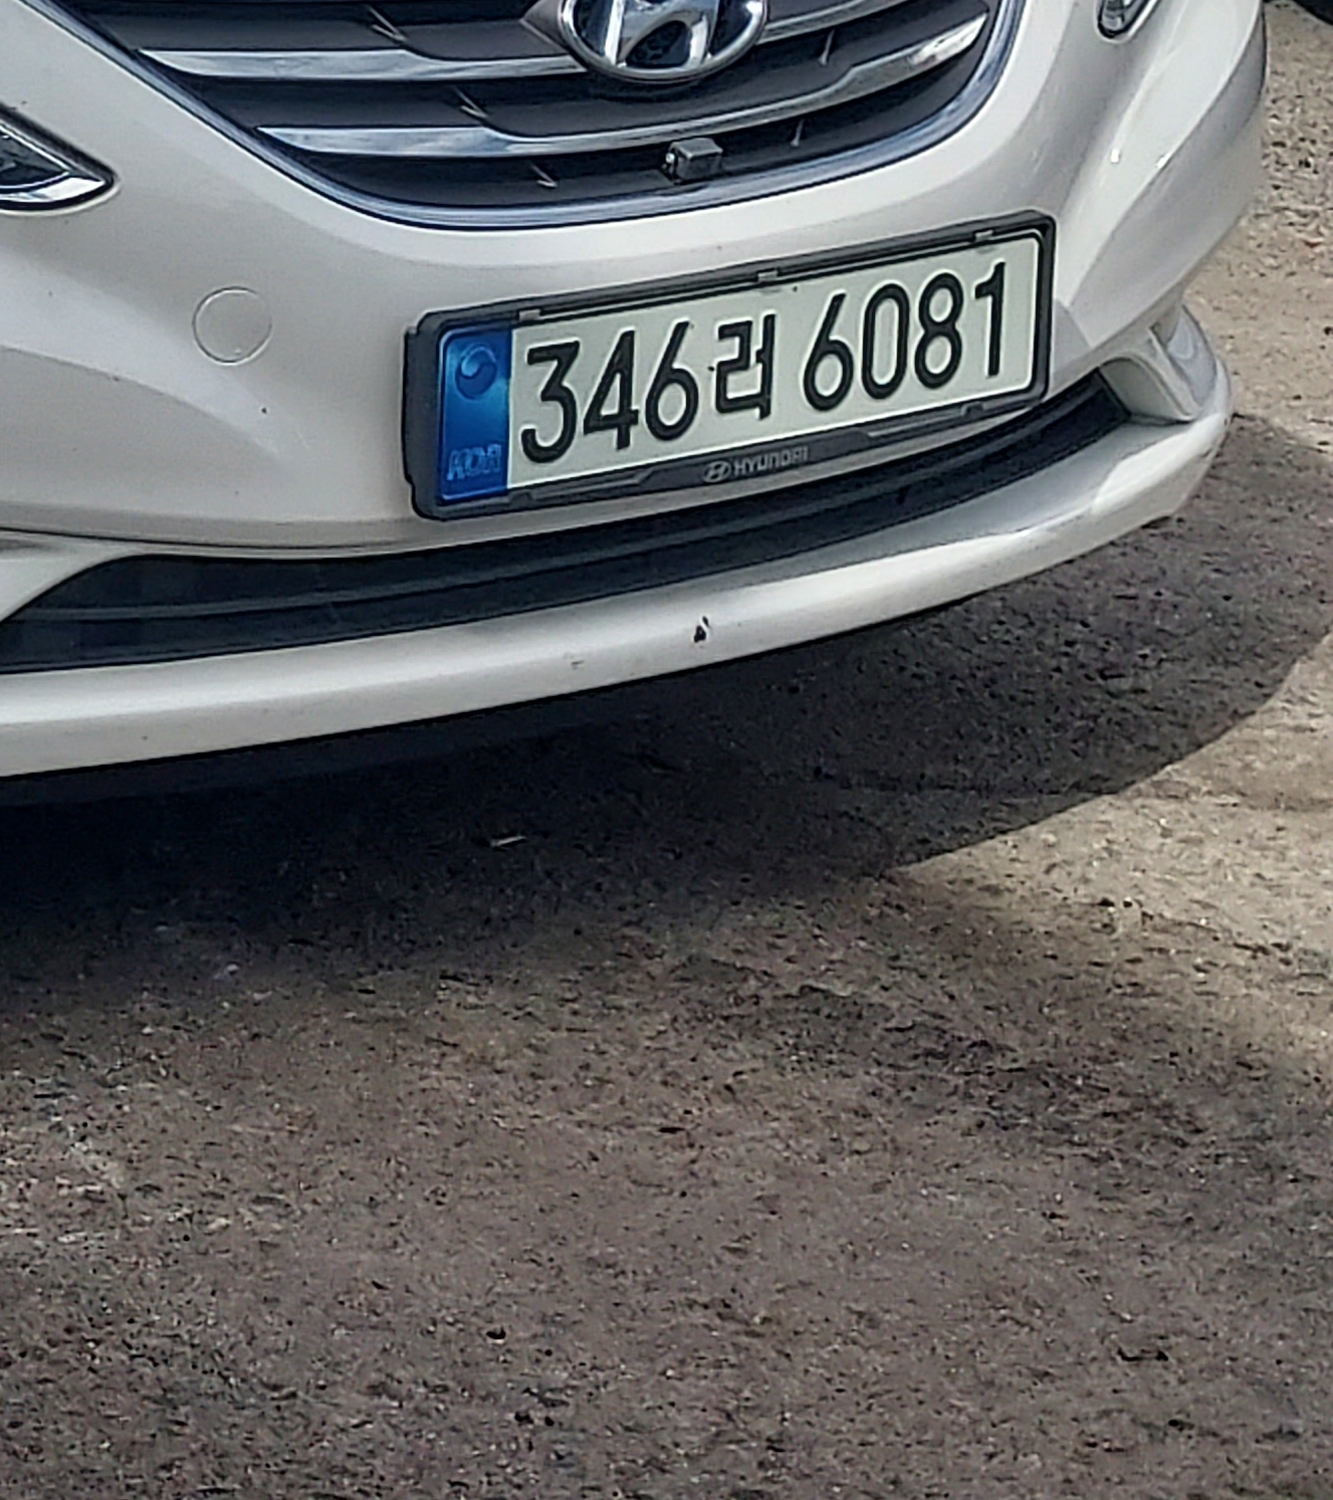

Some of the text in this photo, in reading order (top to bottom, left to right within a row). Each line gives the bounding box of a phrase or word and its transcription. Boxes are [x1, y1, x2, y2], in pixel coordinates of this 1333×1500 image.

[521, 261, 1007, 463] 346러 6081
[734, 445, 809, 477] HYUNDAI
